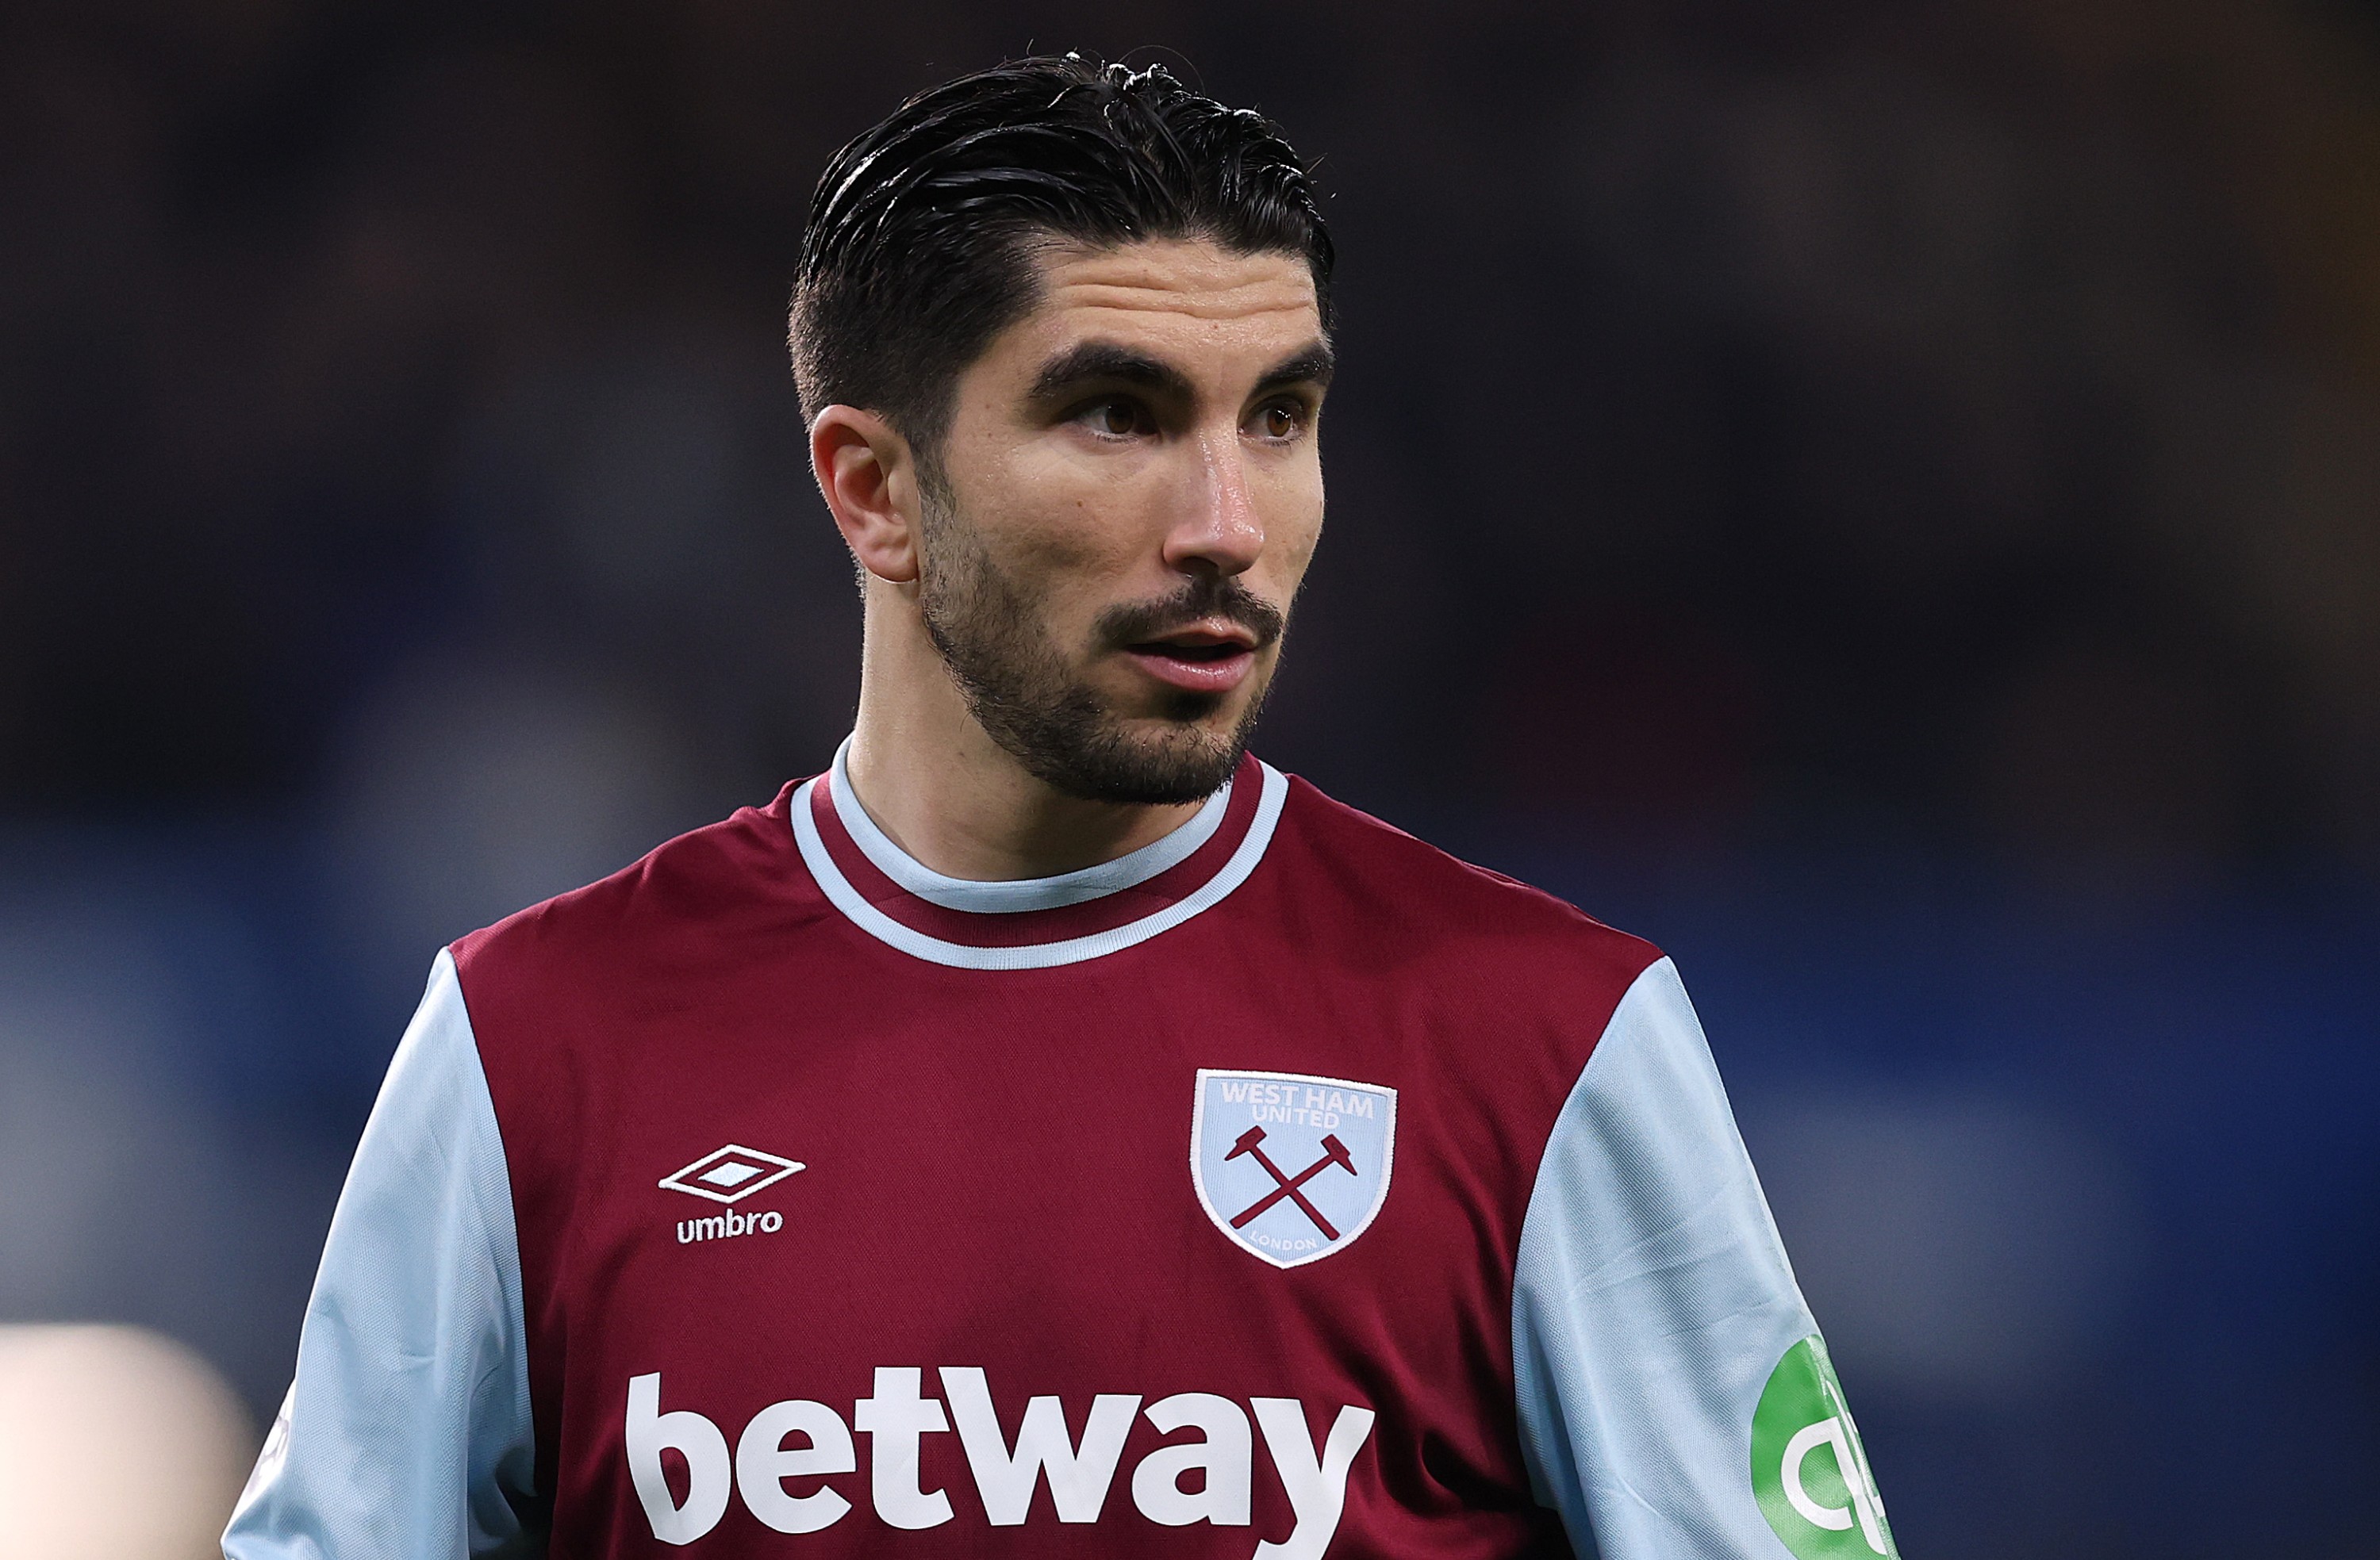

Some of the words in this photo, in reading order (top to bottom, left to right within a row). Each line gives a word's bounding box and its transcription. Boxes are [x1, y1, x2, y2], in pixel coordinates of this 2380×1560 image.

[1222, 1083, 1299, 1106] WEST
[1305, 1087, 1374, 1119] HAM
[1252, 1104, 1339, 1129] UNITED
[677, 1208, 784, 1244] umbro
[1250, 1232, 1318, 1251] LONDON
[624, 1366, 1376, 1560] betway
